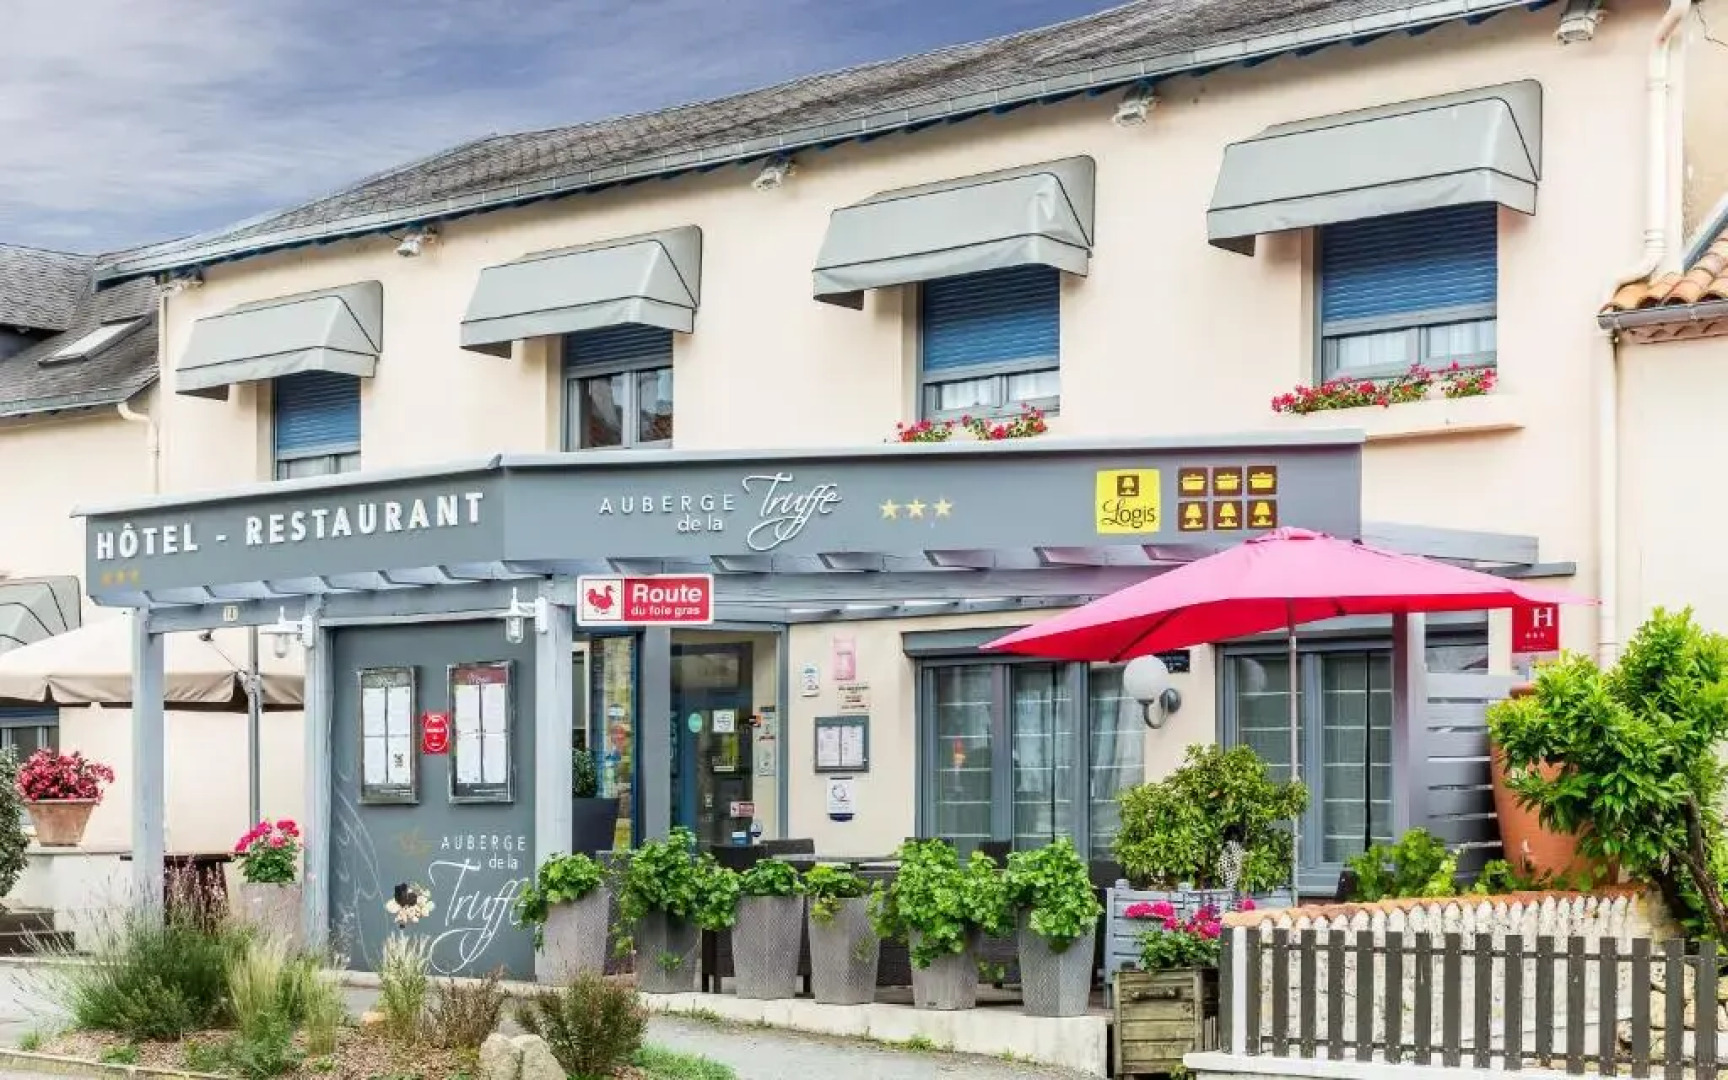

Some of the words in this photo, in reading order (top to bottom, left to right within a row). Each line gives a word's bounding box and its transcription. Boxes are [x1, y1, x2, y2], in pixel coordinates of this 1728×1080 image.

[598, 494, 736, 514] AUBERGE
[742, 472, 843, 550] Truffe
[1101, 499, 1156, 529] Logis
[97, 522, 198, 559] HÔTEL
[246, 492, 485, 546] RESTAURANT
[677, 514, 701, 532] de
[708, 514, 724, 532] la
[632, 583, 703, 603] Route
[630, 605, 646, 615] du
[649, 605, 672, 615] foie
[674, 606, 701, 618] gras
[1532, 607, 1553, 628] H
[440, 835, 527, 851] AUBERGE
[488, 852, 504, 869] de
[507, 856, 519, 869] la
